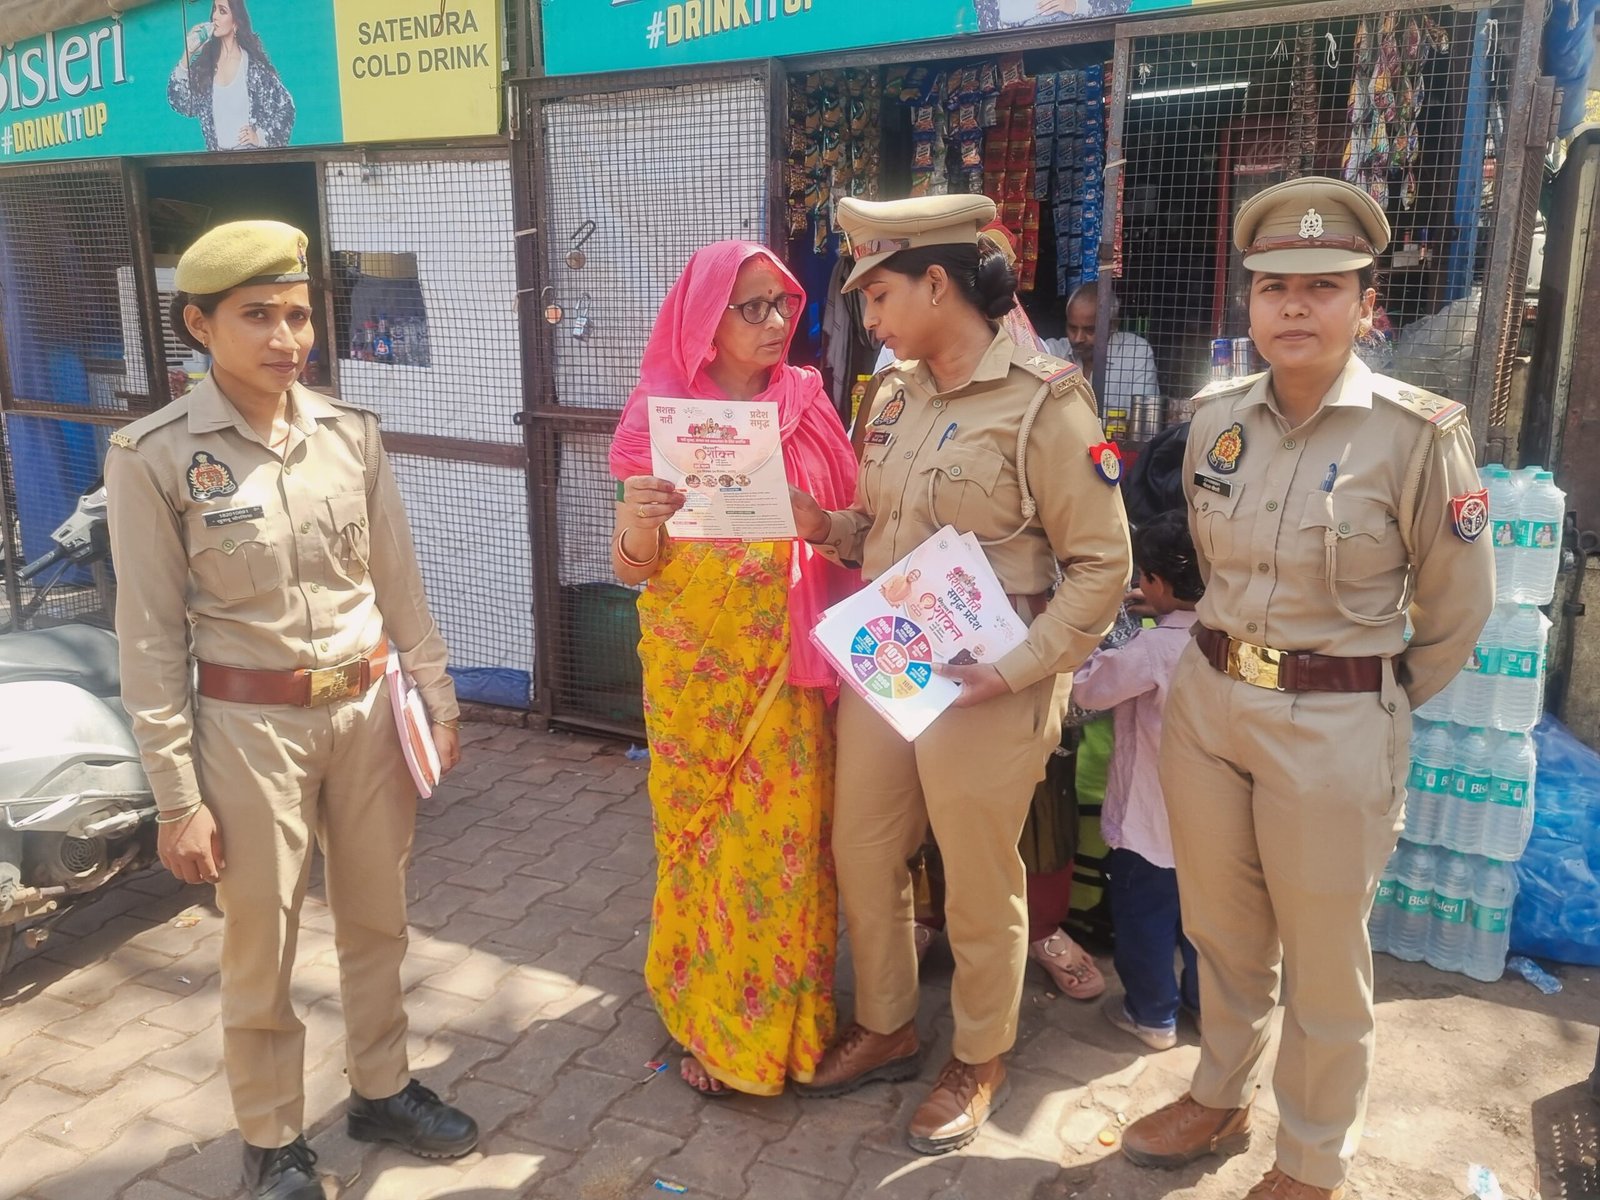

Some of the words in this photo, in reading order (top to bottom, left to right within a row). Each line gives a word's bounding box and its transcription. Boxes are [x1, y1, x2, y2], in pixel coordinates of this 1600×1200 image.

[358, 10, 478, 45] SATENDRA
[352, 52, 411, 79] COLD
[418, 43, 489, 72] DRINK
[1, 103, 107, 155] #DRINKITUP
[963, 609, 982, 631] प्रदेश
[884, 644, 906, 668] 1076
